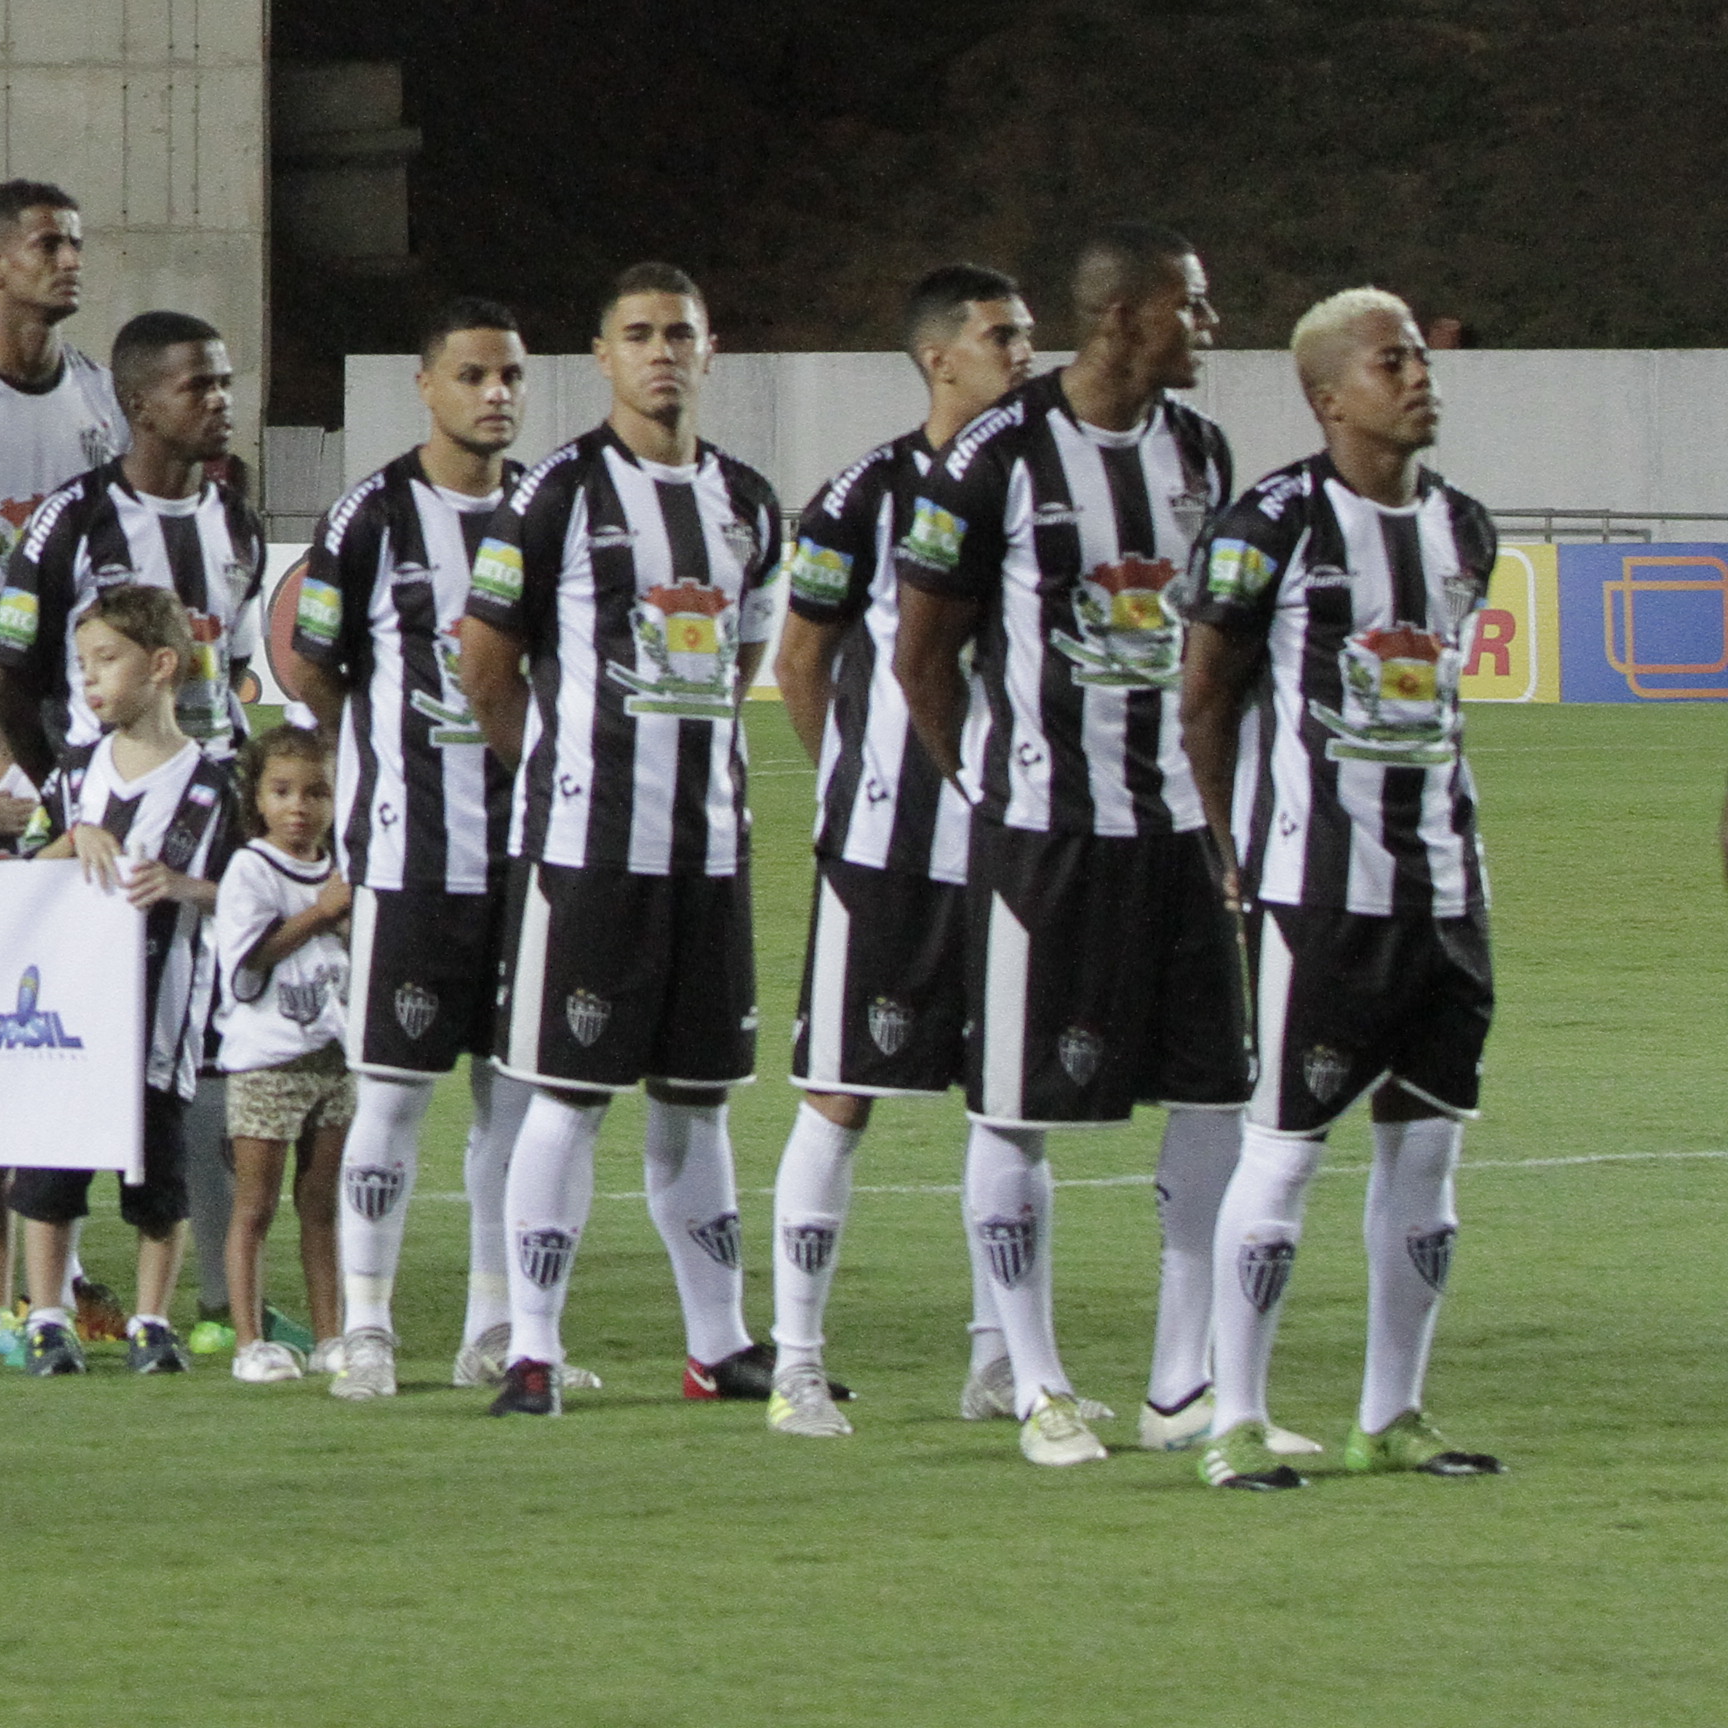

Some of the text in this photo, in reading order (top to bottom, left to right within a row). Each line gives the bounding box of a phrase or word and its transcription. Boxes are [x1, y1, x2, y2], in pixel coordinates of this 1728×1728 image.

[510, 443, 579, 516] Rhumy
[946, 398, 1024, 480] Rhumy
[325, 473, 385, 555] Rhumy
[823, 443, 894, 519] Rhumy
[24, 482, 85, 563] Rhumy
